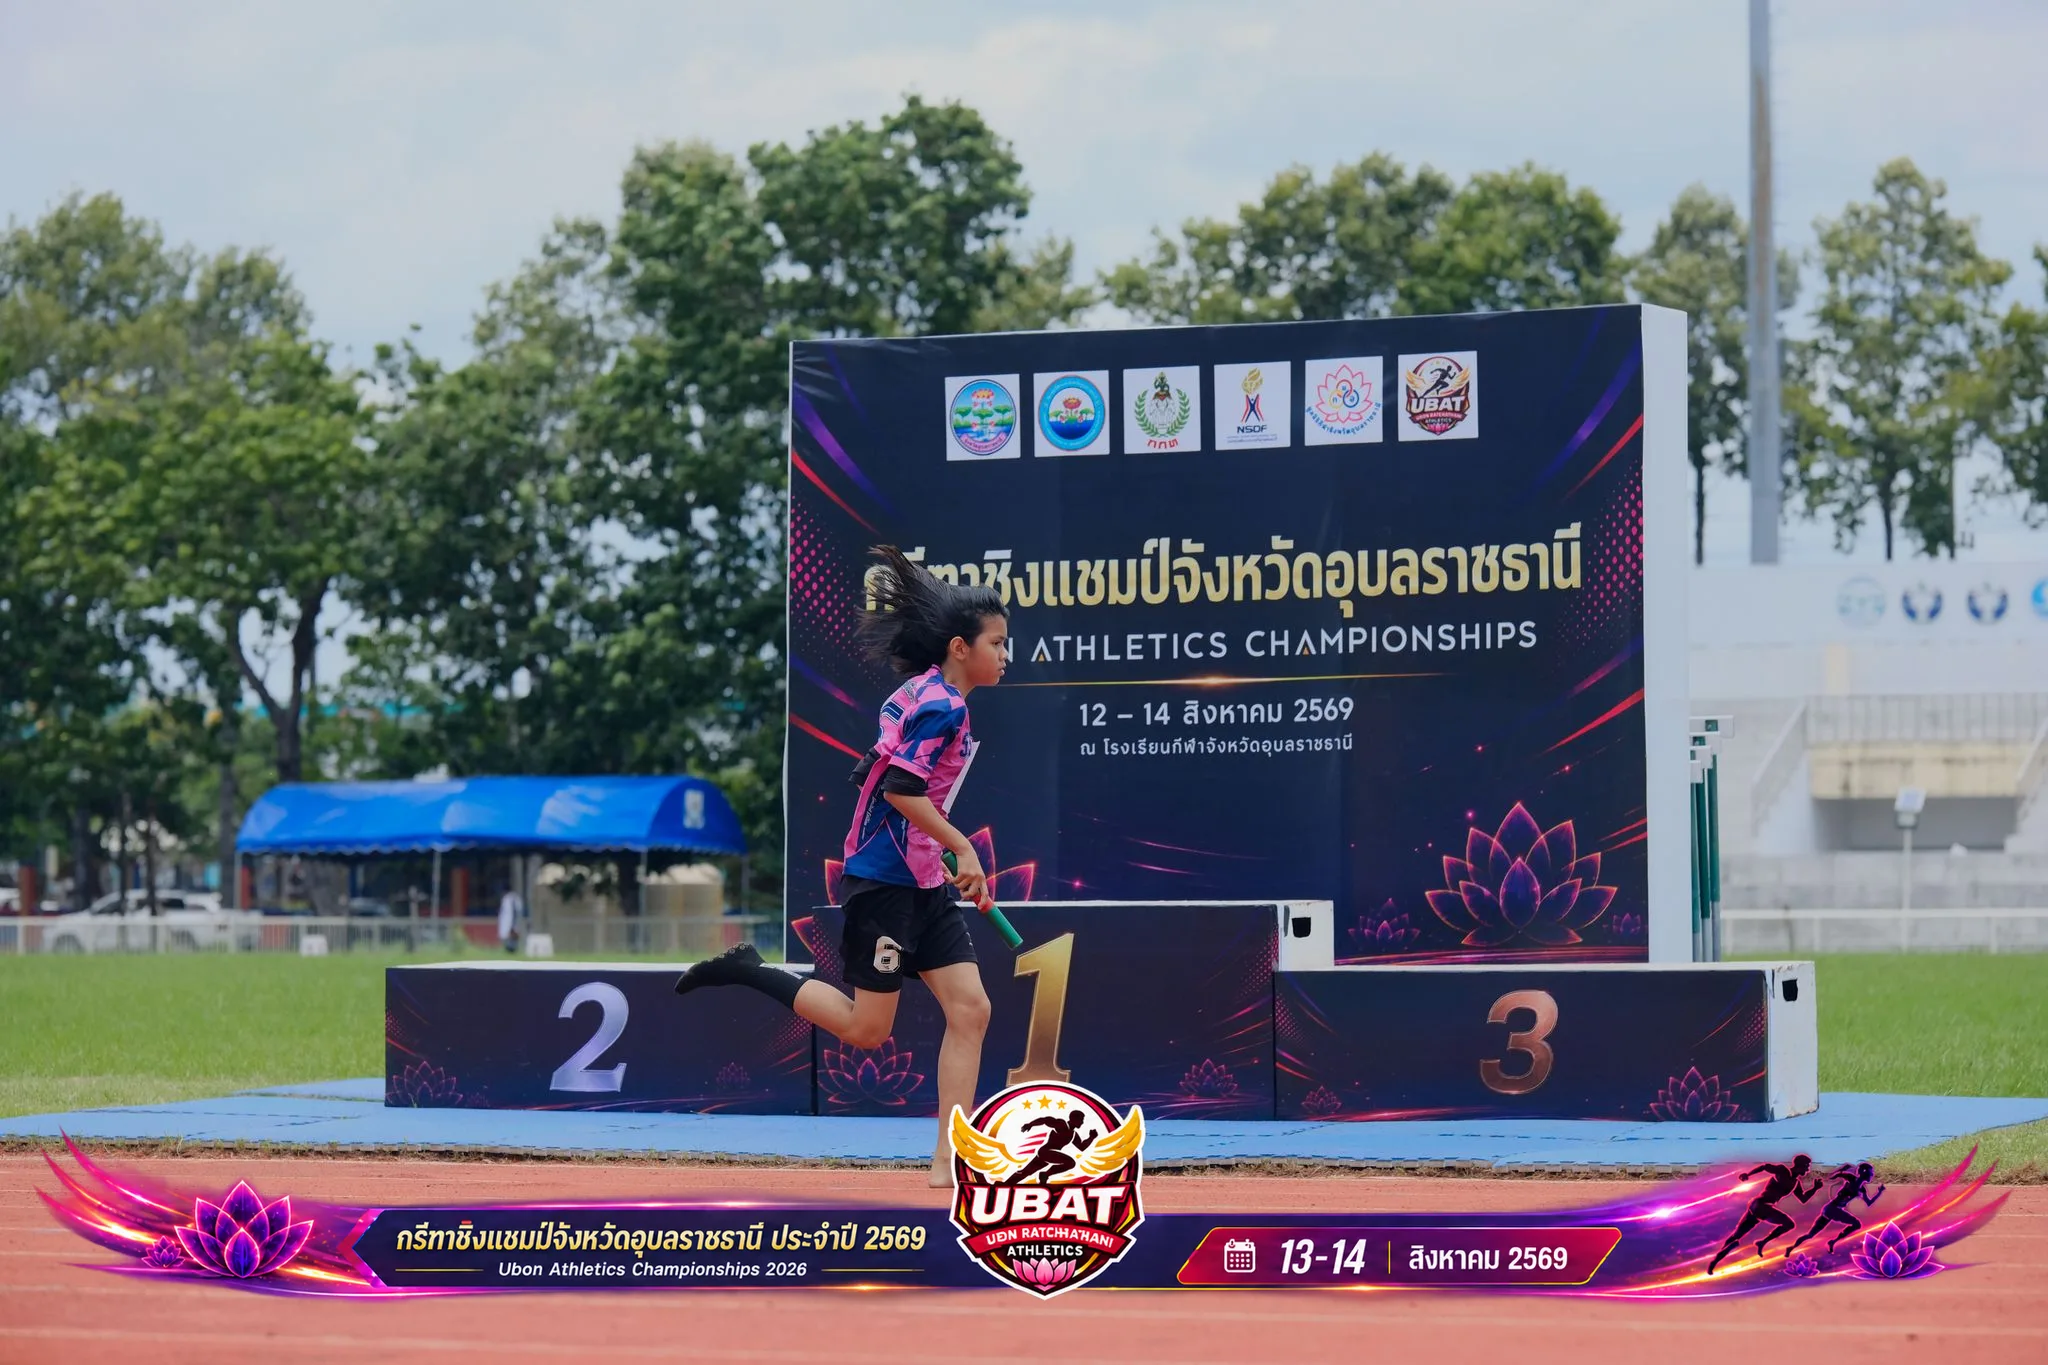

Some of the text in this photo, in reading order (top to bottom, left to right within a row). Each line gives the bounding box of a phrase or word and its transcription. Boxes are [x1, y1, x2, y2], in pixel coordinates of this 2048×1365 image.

[1411, 396, 1466, 415] UBAT
[1236, 425, 1267, 434] NSDF
[1030, 631, 1228, 663] ATHLETICS
[1245, 620, 1537, 657] CHAMPIONSHIPS
[1079, 702, 1107, 726] 12
[1143, 701, 1171, 726] 14
[1183, 699, 1283, 725] สิงหาคม
[1293, 696, 1354, 722] 2569
[1080, 733, 1353, 757] ณ โรงเรียนกีฬาจังหวัดอุบลราชธานี
[1006, 932, 1075, 1087] 1
[549, 981, 630, 1093] 2
[1479, 989, 1559, 1095] 3
